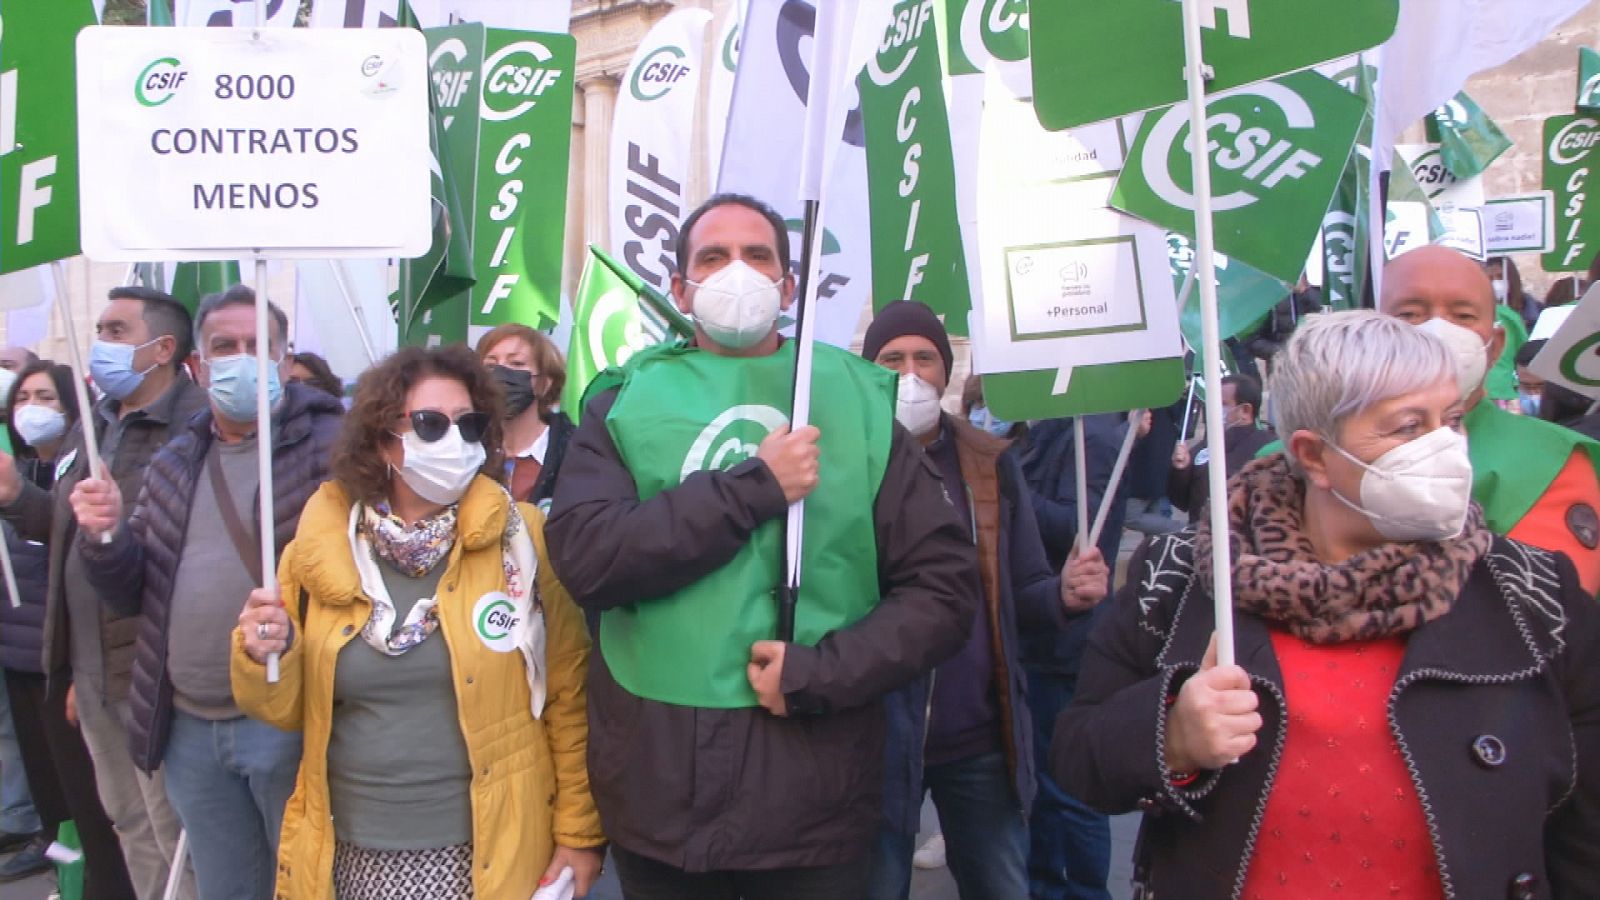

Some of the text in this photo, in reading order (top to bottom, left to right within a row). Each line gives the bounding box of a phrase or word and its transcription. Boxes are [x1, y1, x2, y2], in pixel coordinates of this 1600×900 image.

[145, 71, 188, 91] CSIF
[488, 64, 562, 96] CSIF
[645, 62, 691, 84] CSIF
[214, 74, 295, 100] 8000
[151, 127, 359, 155] CONTRATOS
[1183, 112, 1323, 189] CSIF
[1561, 131, 1600, 151] CSIF
[193, 183, 319, 210] MENOS
[896, 87, 930, 301] CSIF
[481, 133, 531, 314] CSIF
[1562, 167, 1589, 266] CSIF
[1047, 302, 1108, 317] +Personal
[487, 611, 520, 630] CSIF
